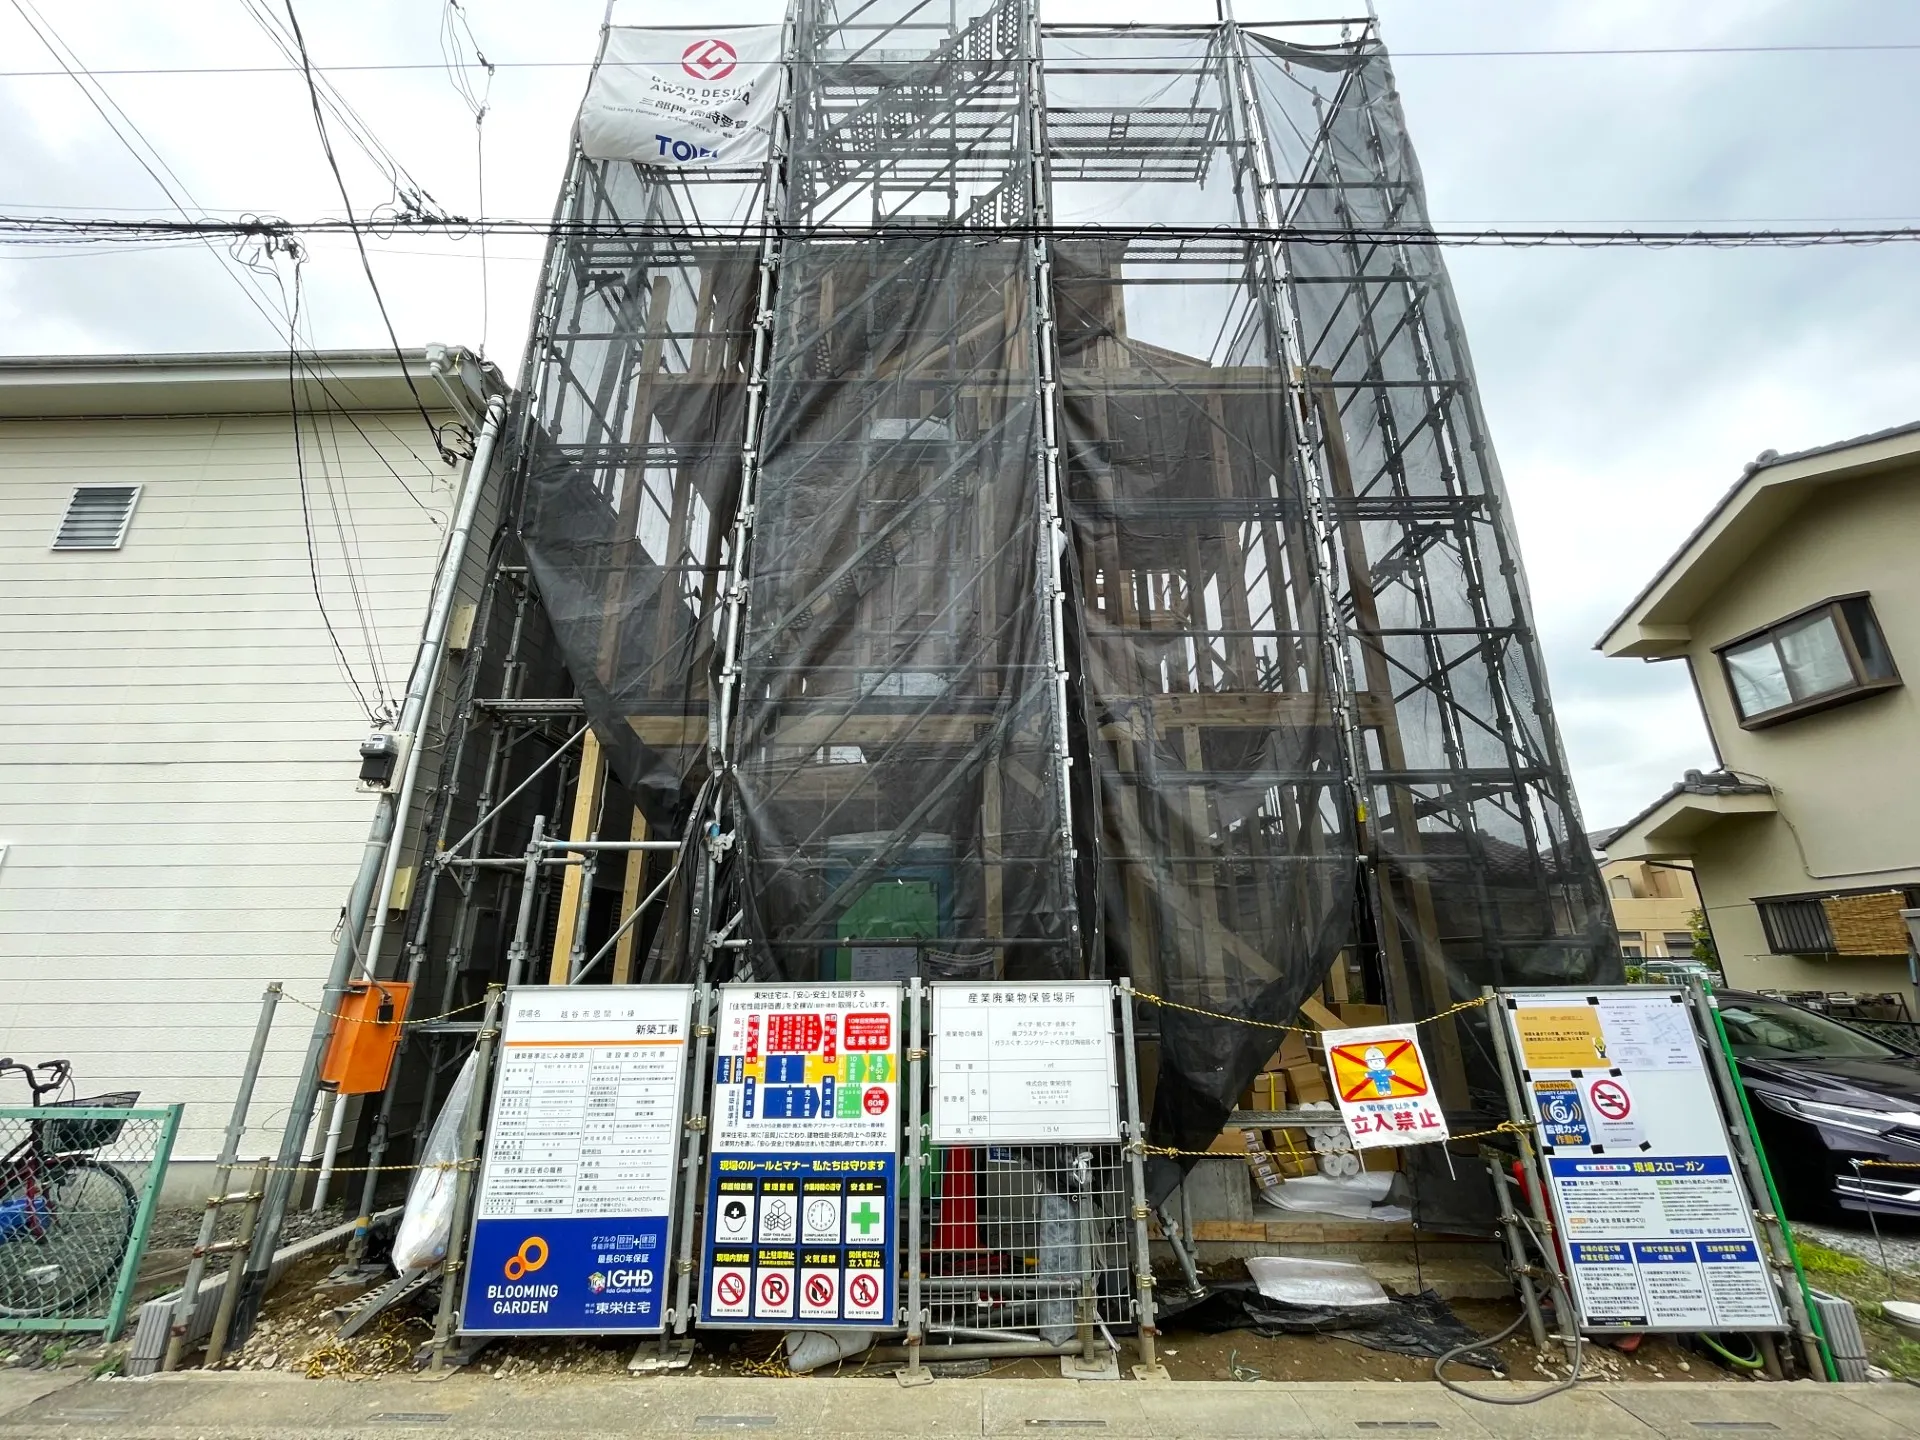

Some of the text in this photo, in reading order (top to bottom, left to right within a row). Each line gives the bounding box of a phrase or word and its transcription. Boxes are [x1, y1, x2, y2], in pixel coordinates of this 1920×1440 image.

[968, 992, 1076, 1004] 産業廃棄物保管場所
[518, 1009, 541, 1018] 現場名
[635, 1024, 678, 1035] 新築工事
[846, 1035, 888, 1046] 延長保証
[970, 1088, 988, 1096] 名称
[943, 1095, 965, 1103] 管理者
[1366, 1101, 1410, 1112] 関係者以外
[1351, 1108, 1441, 1135] 立入禁止
[955, 1127, 974, 1135] 高さ
[1546, 1124, 1587, 1135] 監視カメラ
[1555, 1134, 1583, 1145] 作動中
[719, 1160, 886, 1171] 現場のルールとマナー 私たちは守ります
[1633, 1161, 1705, 1173] 現場スローガン
[763, 1182, 794, 1191] 整理整頓
[850, 1182, 882, 1191] 安全第一
[592, 1235, 617, 1243] ダブルの
[597, 1253, 650, 1264] 最長60年保証
[716, 1253, 750, 1263] 現場内禁煙
[758, 1250, 795, 1260] 路上駐車禁止
[804, 1254, 836, 1264] 火気厳禁
[848, 1250, 880, 1259] 関係者以外
[848, 1259, 881, 1268] 立入禁止
[606, 1269, 654, 1288] IGHD
[487, 1284, 559, 1299] BLOOMING
[493, 1300, 549, 1315] GARDEN
[595, 1301, 651, 1314] 東栄住宅
